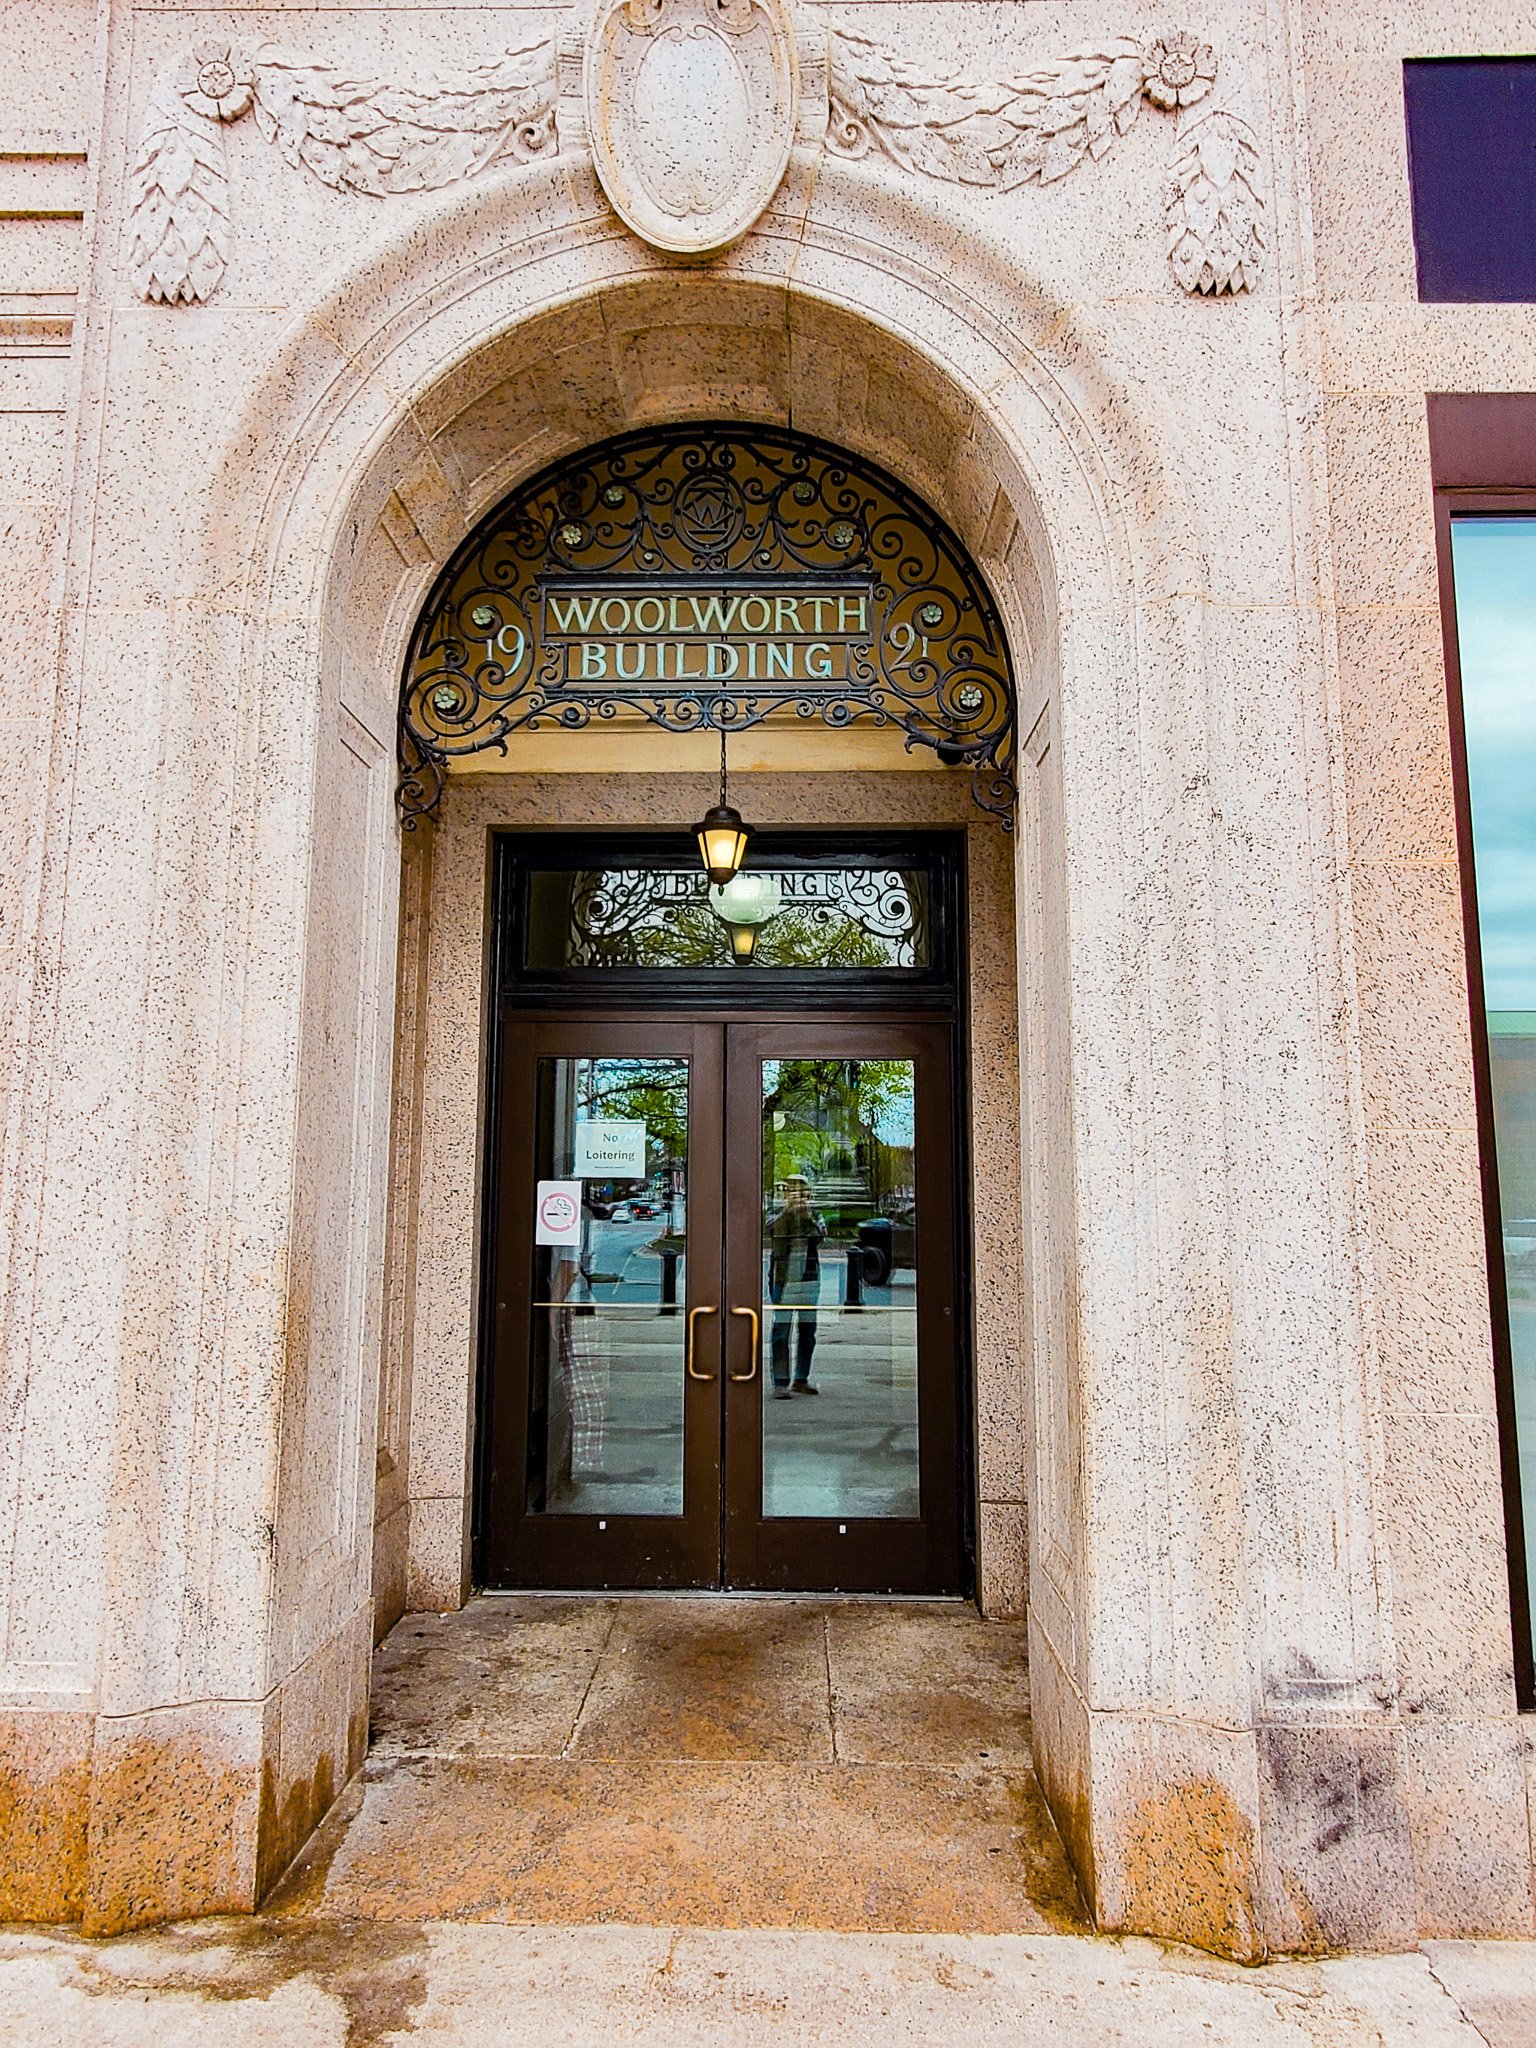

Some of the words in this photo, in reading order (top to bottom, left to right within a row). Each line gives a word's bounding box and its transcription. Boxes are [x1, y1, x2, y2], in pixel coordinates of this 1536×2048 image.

[548, 596, 867, 634] WOOLWORTH
[581, 642, 833, 680] BUILDING
[602, 1133, 618, 1143] No
[586, 1150, 635, 1162] Loitering
